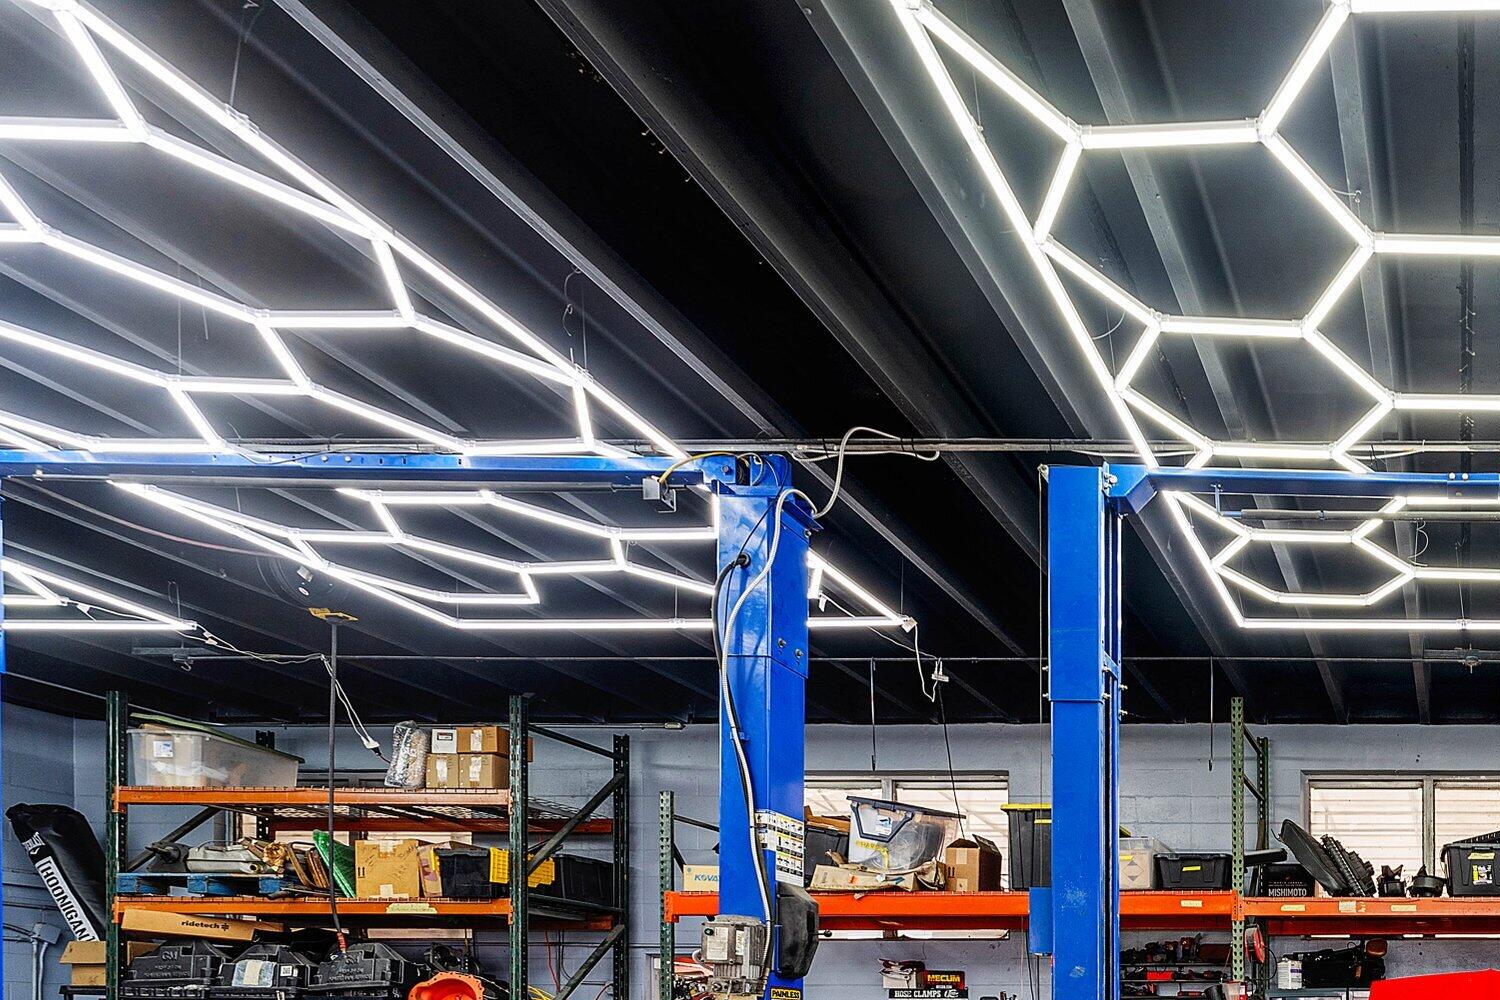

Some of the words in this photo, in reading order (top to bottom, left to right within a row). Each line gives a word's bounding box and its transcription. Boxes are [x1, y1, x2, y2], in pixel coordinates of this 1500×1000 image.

[1268, 888, 1307, 897] MISHIMOTO
[181, 920, 220, 930] ridetech
[927, 974, 961, 983] MECUM
[771, 989, 800, 999] PAINLESS
[894, 990, 912, 998] HOSE
[913, 990, 942, 998] CLAMPS
